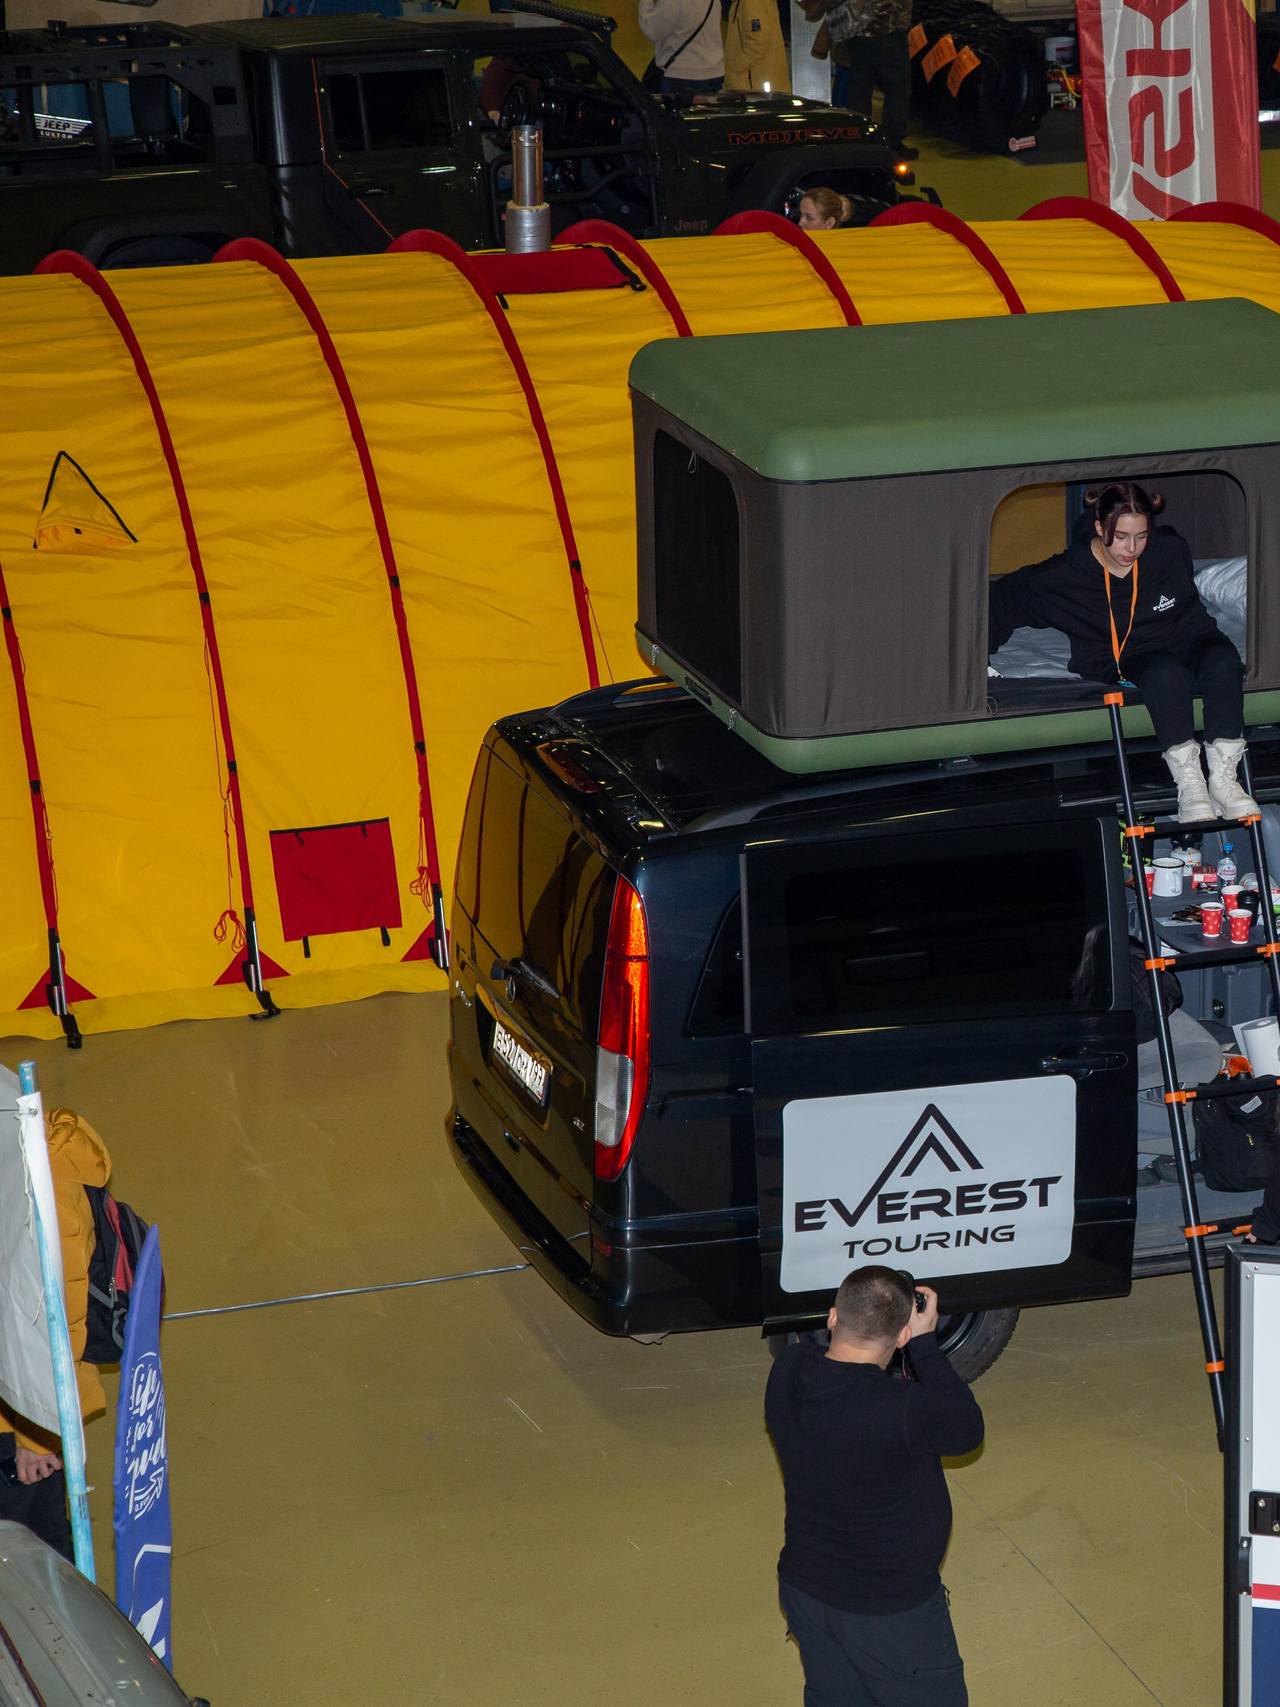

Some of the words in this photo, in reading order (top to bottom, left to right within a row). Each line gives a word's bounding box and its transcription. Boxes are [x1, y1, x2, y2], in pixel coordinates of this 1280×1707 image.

[43, 120, 71, 131] JEEP
[40, 130, 73, 139] CUSTOM
[728, 127, 862, 146] MOJAVE
[673, 218, 708, 233] Jeep
[795, 1175, 1063, 1233] EVEREST
[842, 1224, 1016, 1259] TOURING
